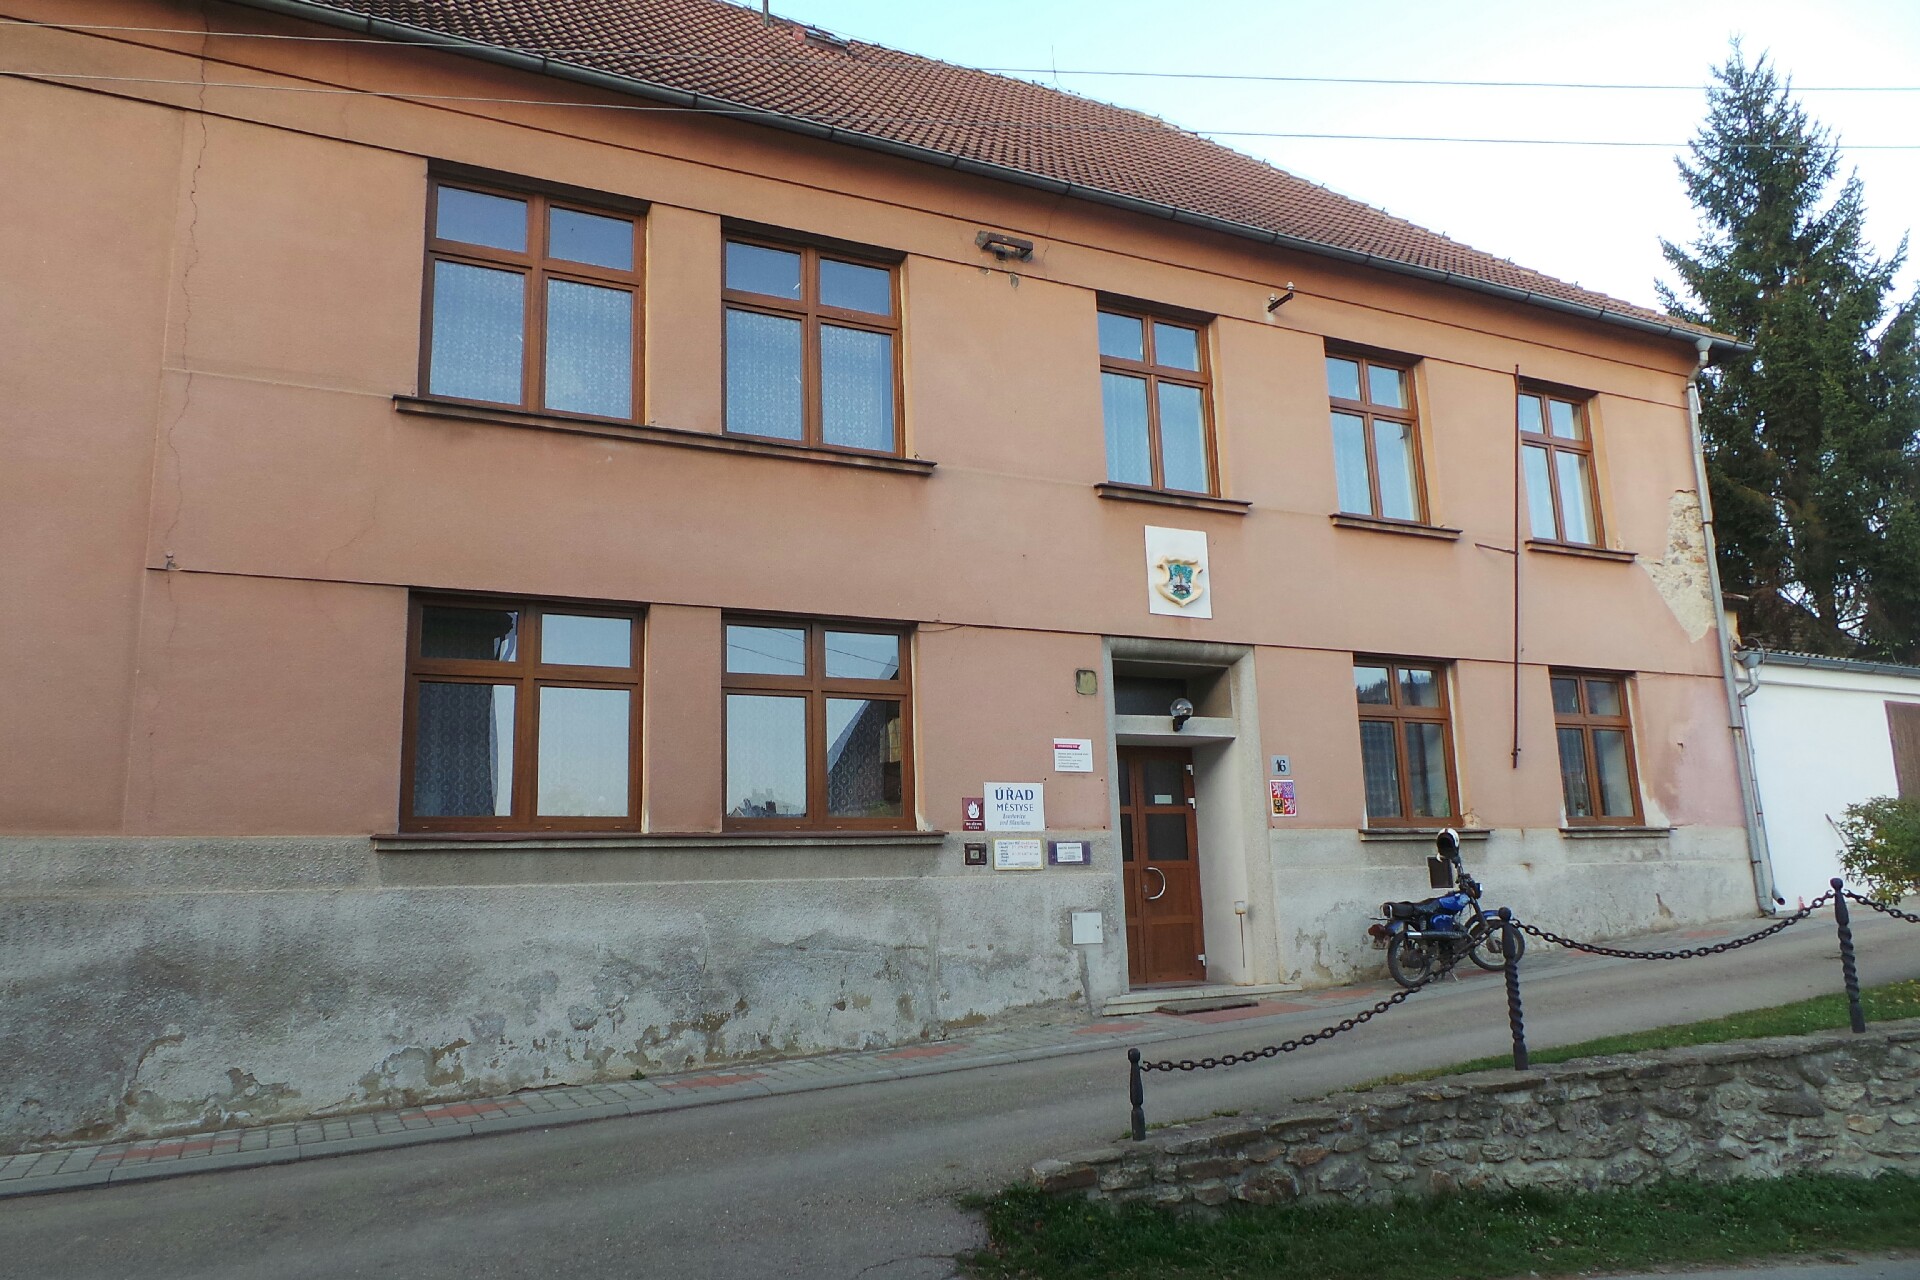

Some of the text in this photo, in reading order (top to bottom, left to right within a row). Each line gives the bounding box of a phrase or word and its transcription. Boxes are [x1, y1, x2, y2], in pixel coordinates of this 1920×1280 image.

[1276, 759, 1287, 772] 16
[995, 787, 1034, 801] ÚŘAD
[996, 803, 1034, 811] MĚSTYSE
